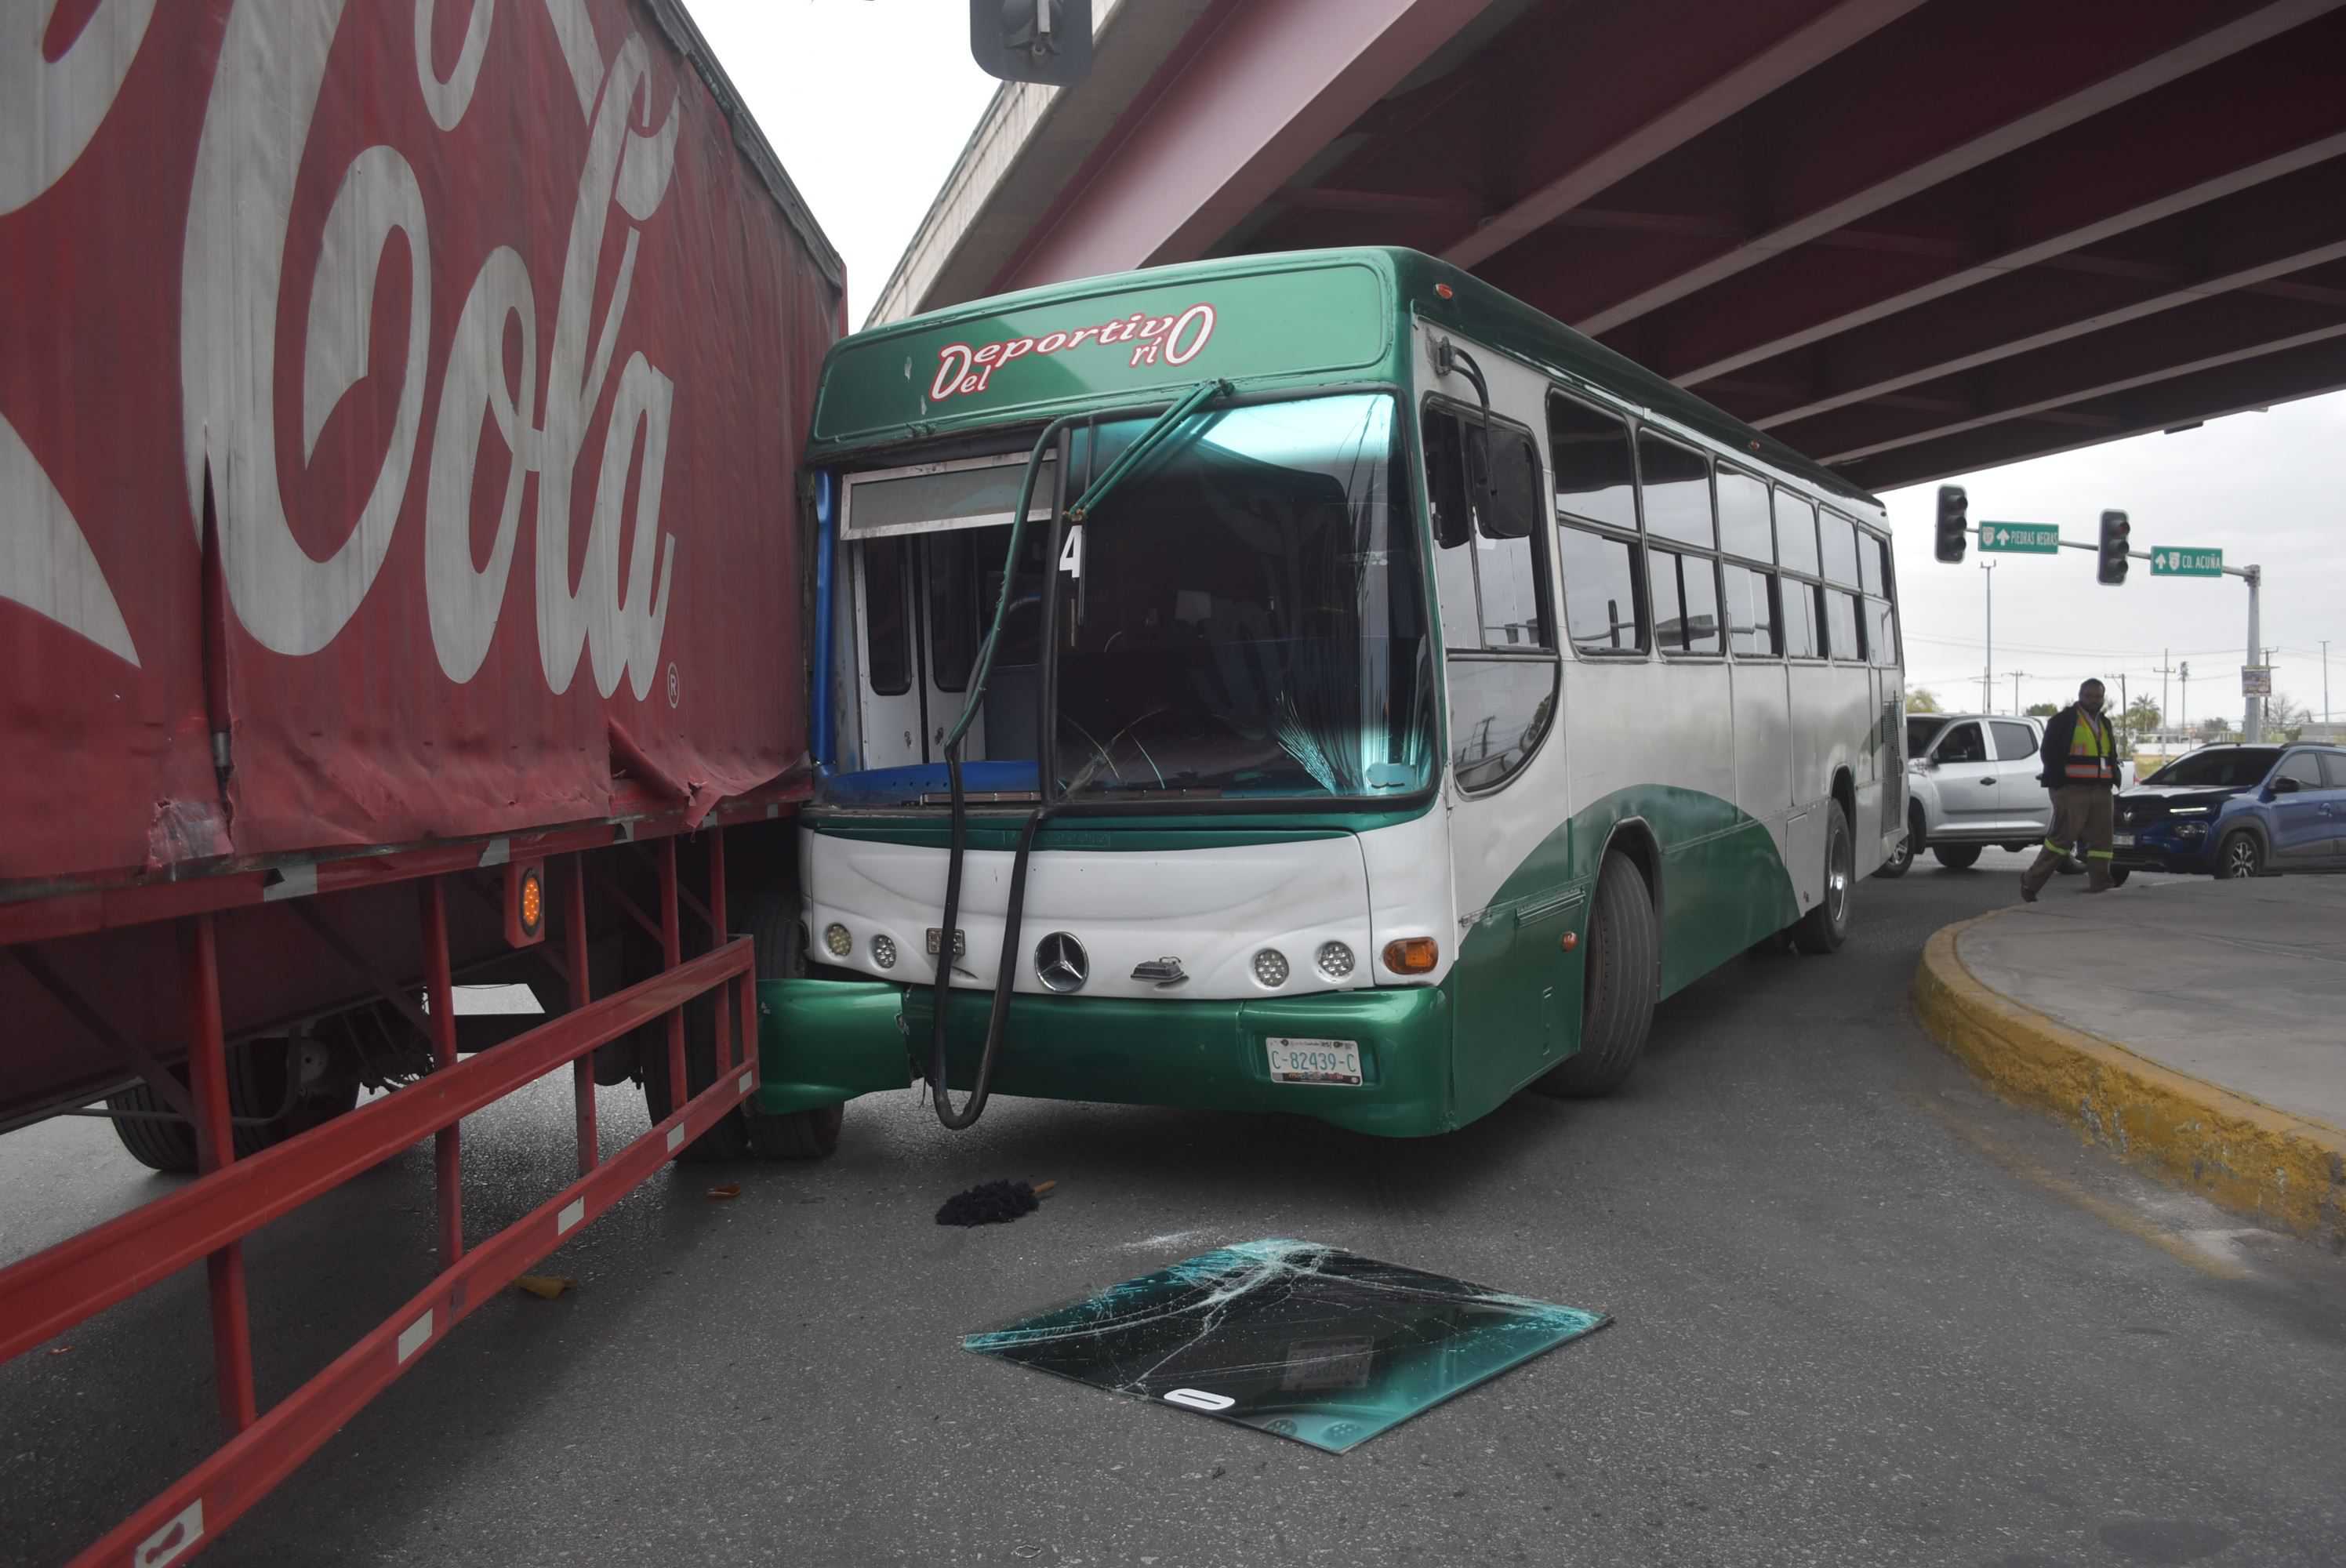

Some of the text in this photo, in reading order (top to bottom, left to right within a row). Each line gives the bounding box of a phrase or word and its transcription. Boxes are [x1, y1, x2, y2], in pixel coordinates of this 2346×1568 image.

[180, 0, 679, 701] Cola
[2010, 530, 2035, 545] PIEDRAS
[2036, 532, 2058, 546] NEGRAS
[1059, 524, 1082, 578] 4
[2195, 554, 2221, 569] ACUÑA
[1272, 1050, 1356, 1073] C-82439-C
